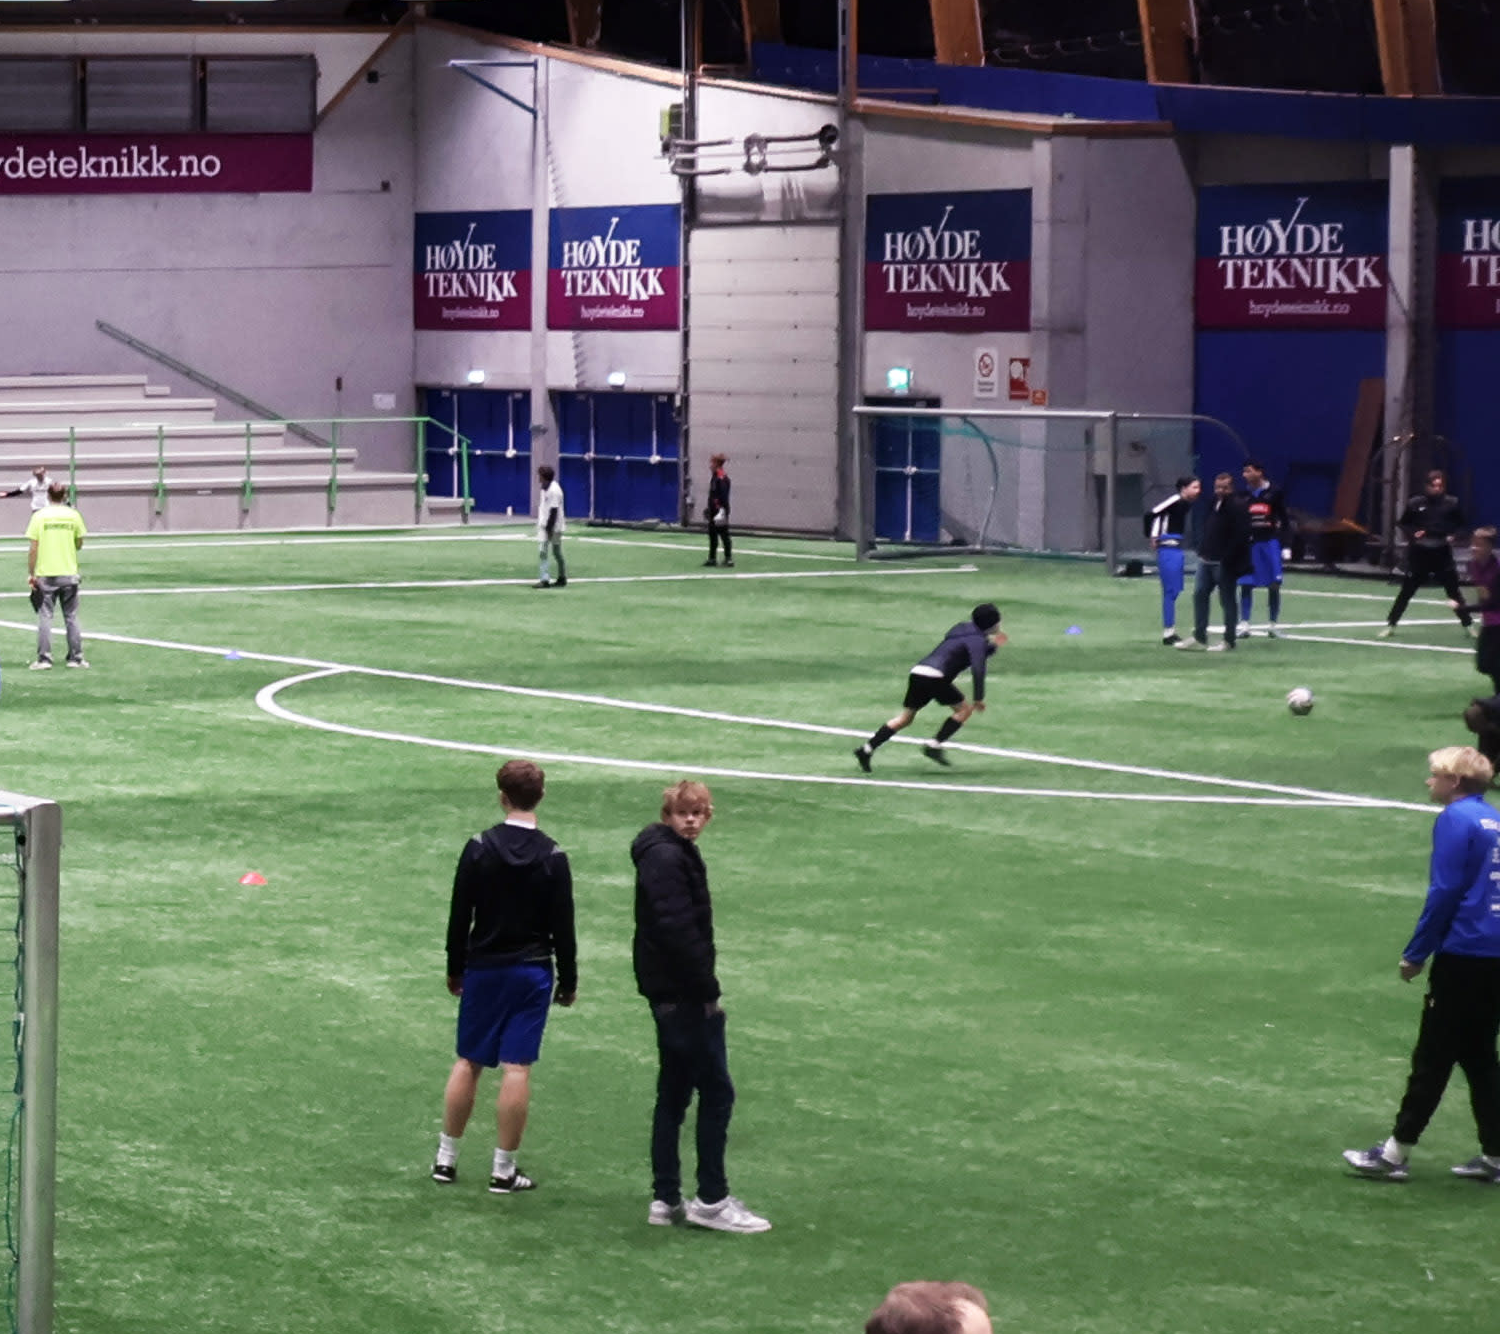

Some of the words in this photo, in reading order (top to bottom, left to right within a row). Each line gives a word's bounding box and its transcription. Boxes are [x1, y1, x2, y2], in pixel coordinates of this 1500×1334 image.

[425, 222, 496, 271] HØYDE
[563, 217, 641, 269] HØYDE
[884, 205, 980, 261] HØYDE
[1219, 197, 1344, 255] HØYDE
[425, 271, 518, 302] TEKNIKK
[561, 267, 665, 301] TEKNIKK
[883, 261, 1011, 297] TEKNIKK
[1218, 255, 1382, 294] TEKNIKK
